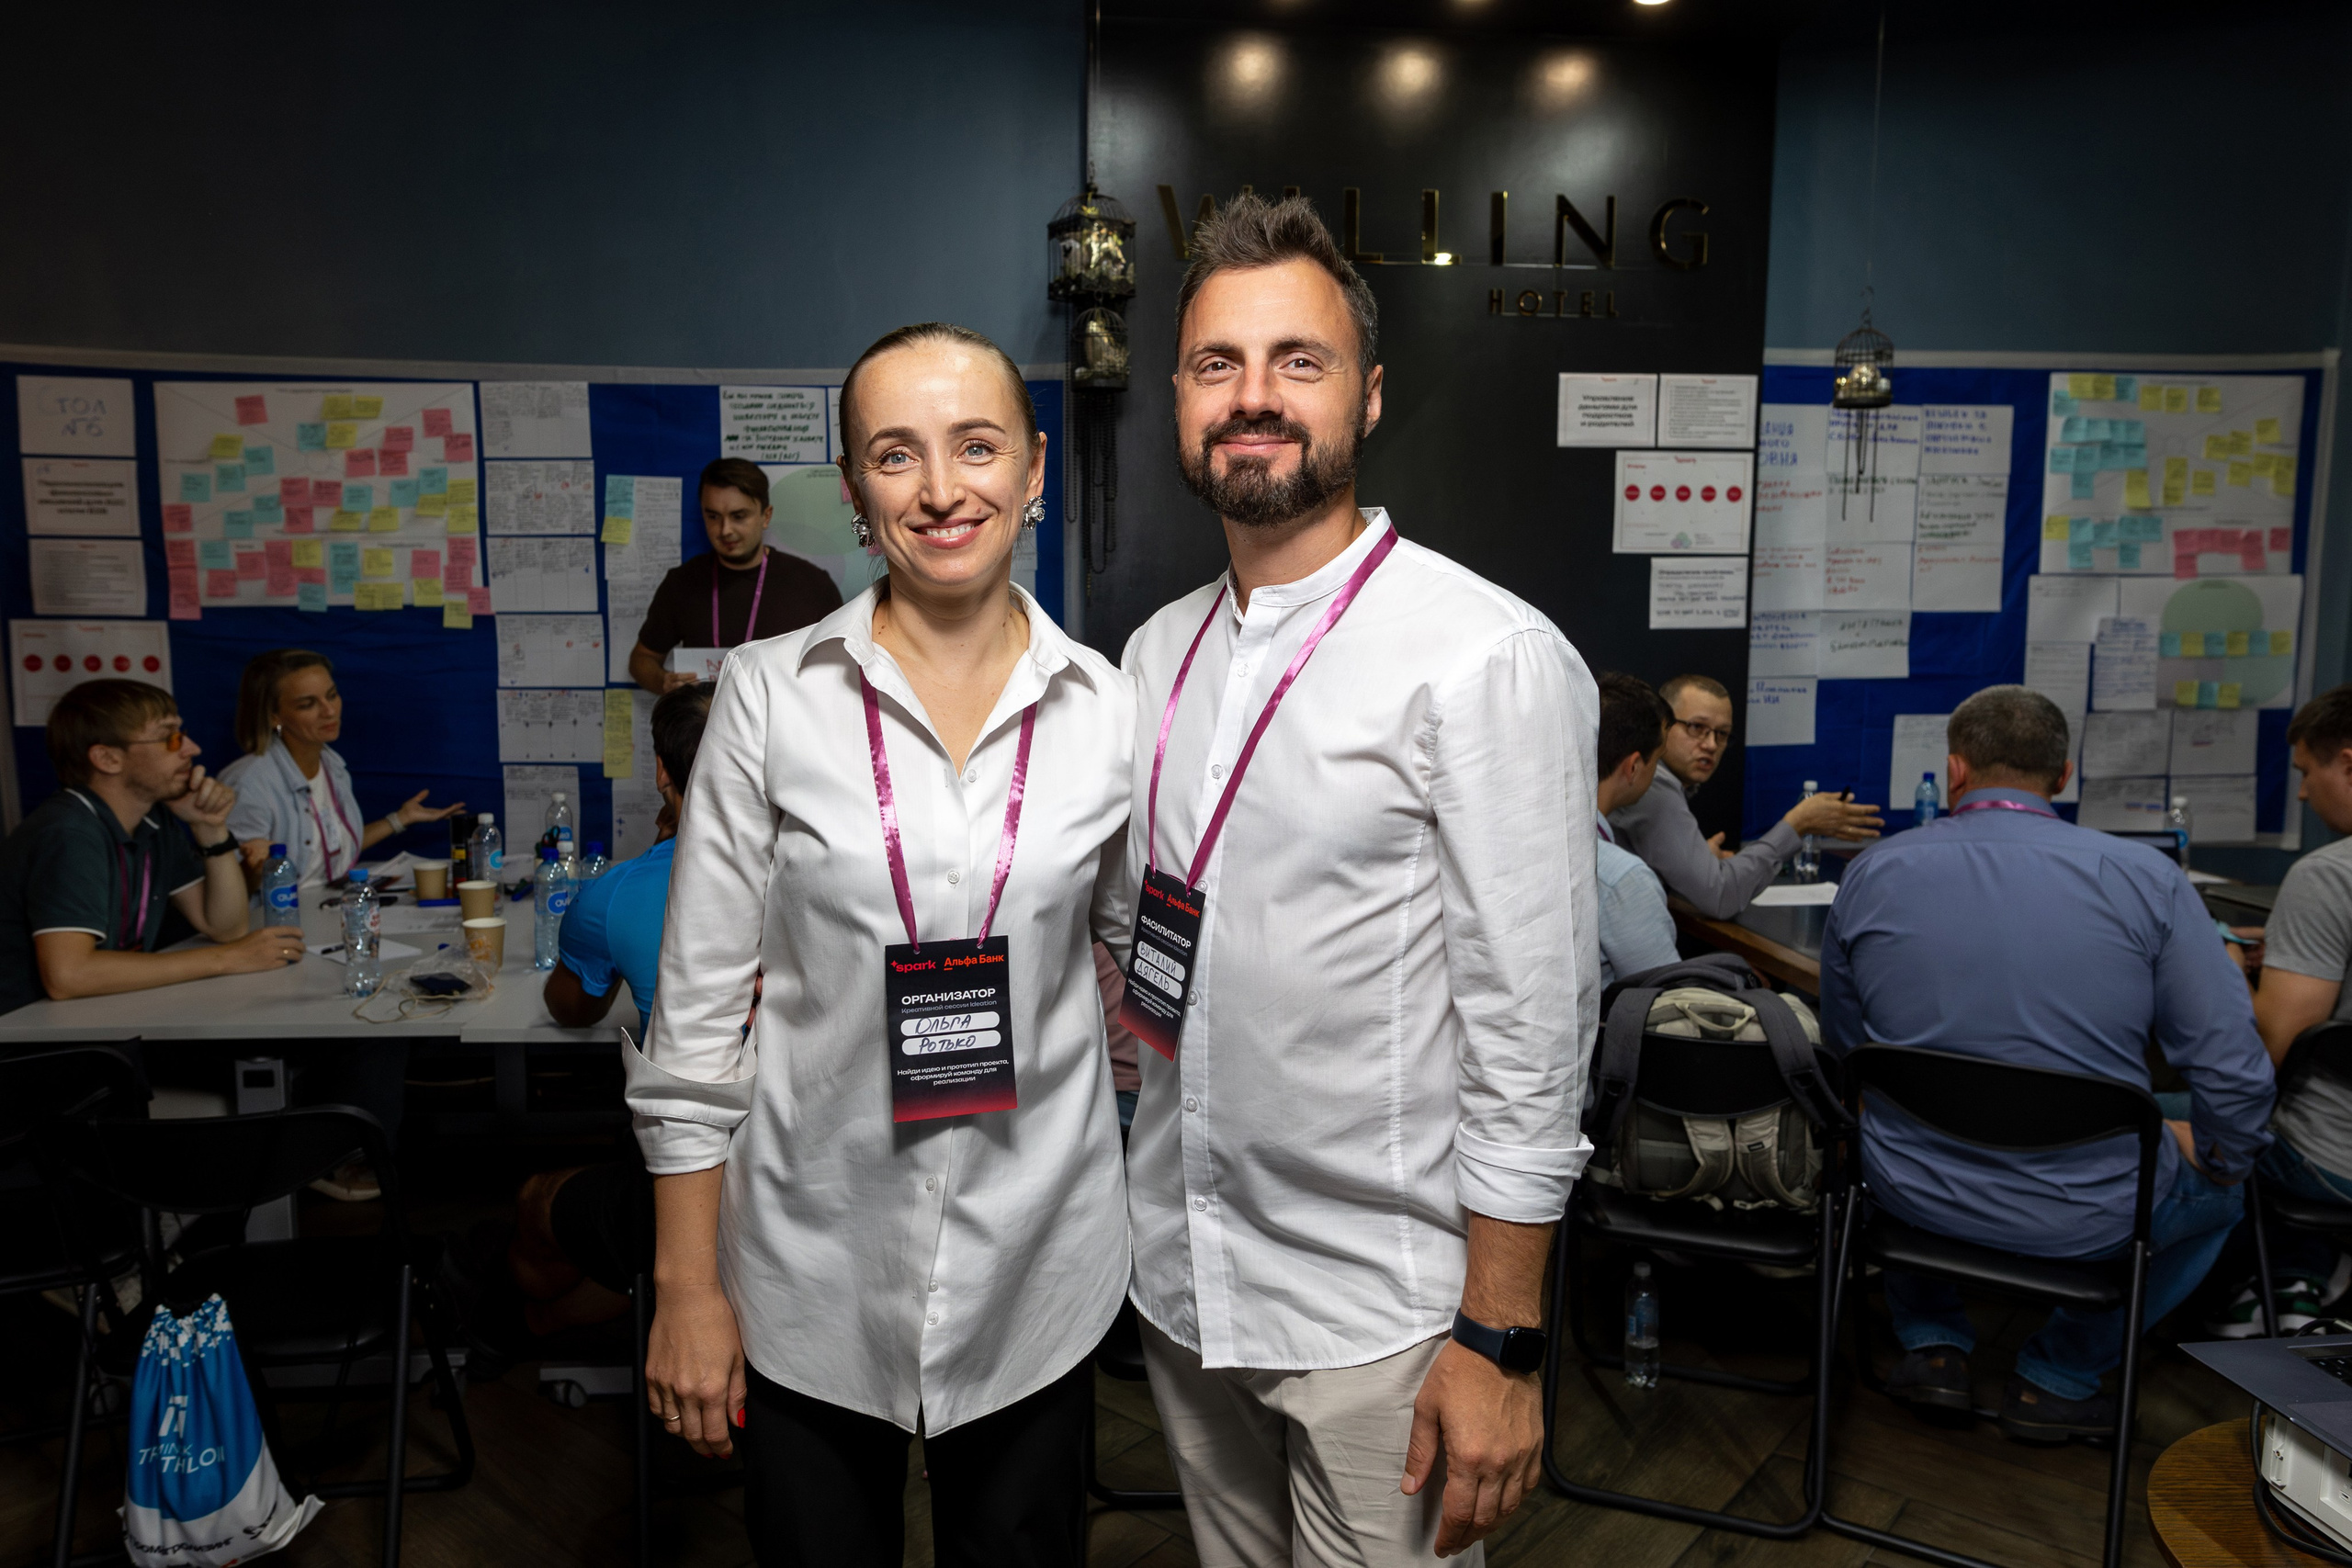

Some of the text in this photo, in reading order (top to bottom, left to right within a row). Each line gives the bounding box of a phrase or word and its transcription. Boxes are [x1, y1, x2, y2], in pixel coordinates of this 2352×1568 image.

[1157, 185, 1710, 270] WLLING
[1488, 288, 1619, 317] HOTEL
[1146, 884, 1165, 900] spark
[1167, 894, 1200, 918] Альфа Банк
[1141, 915, 1192, 949] ФАСИЛИТАТОР
[896, 960, 936, 973] spark
[944, 954, 1004, 970] Альфа Банк
[1140, 942, 1176, 976] ВИТАЛИЙ
[1136, 961, 1170, 991] ДЯГЕЛЬ
[901, 988, 996, 1005] ОРГАНИЗАТОР
[901, 1005, 944, 1014] Креативной
[915, 1014, 972, 1034] ОЛЬГА
[947, 1063, 978, 1071] прототип
[979, 1059, 1009, 1067] проекта,
[910, 1073, 953, 1082] сформируй
[954, 1069, 983, 1077] команду
[933, 1077, 976, 1086] реализации
